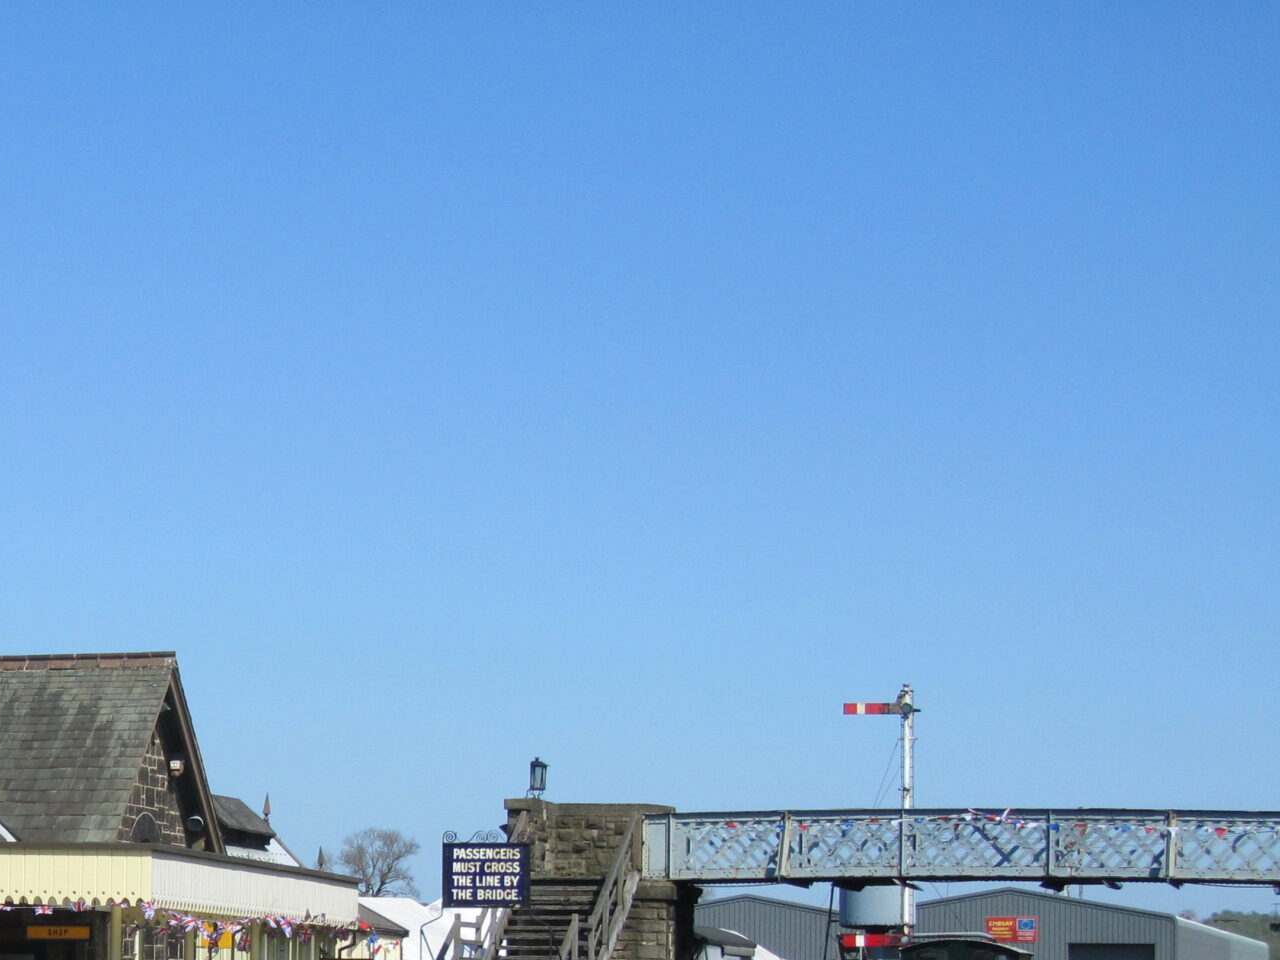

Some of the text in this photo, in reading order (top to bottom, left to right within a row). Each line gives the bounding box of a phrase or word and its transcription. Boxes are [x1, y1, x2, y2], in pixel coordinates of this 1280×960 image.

[453, 848, 521, 860] PASSENGERS
[452, 861, 520, 873] MUST CROSS
[452, 875, 520, 887] THE LINE BY
[451, 889, 522, 901] THE BRIDGE.
[47, 928, 69, 937] SHOP
